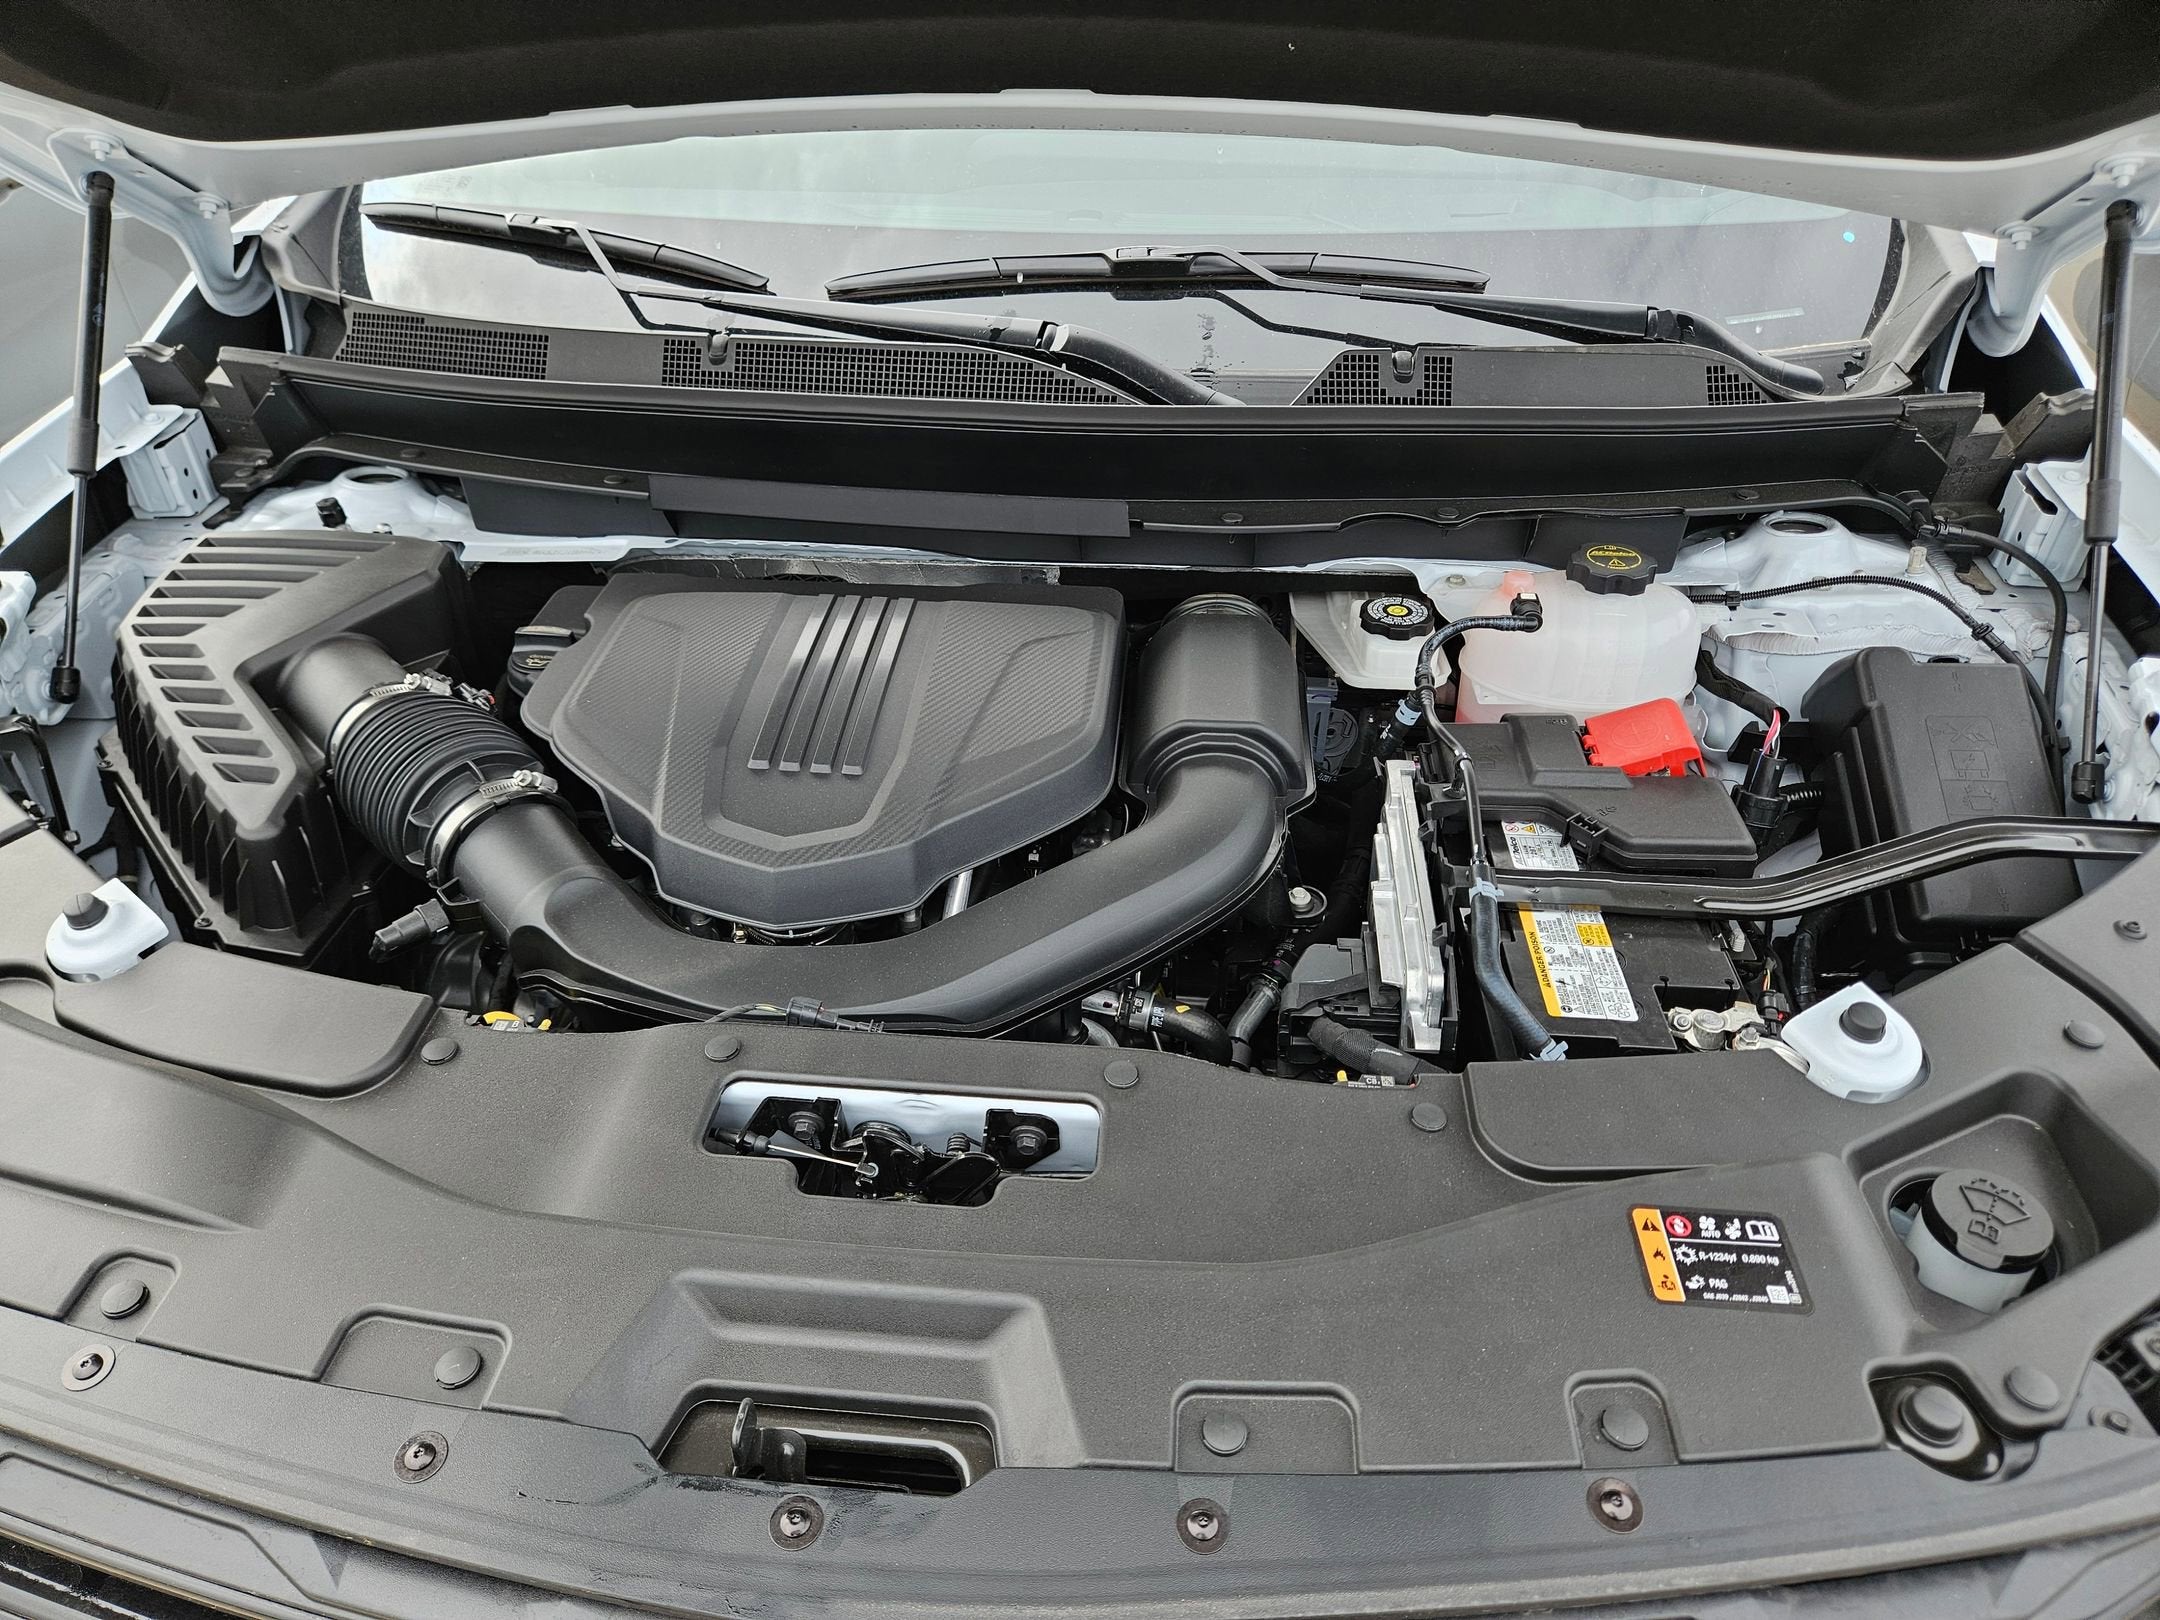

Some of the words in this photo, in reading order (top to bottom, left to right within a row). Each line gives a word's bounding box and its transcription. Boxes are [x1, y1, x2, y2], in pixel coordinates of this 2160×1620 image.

[1528, 931, 1541, 954] POISON
[1535, 956, 1549, 981] DANGER
[1701, 1230, 1721, 1239] AUTO
[1708, 1278, 1729, 1290] PAG
